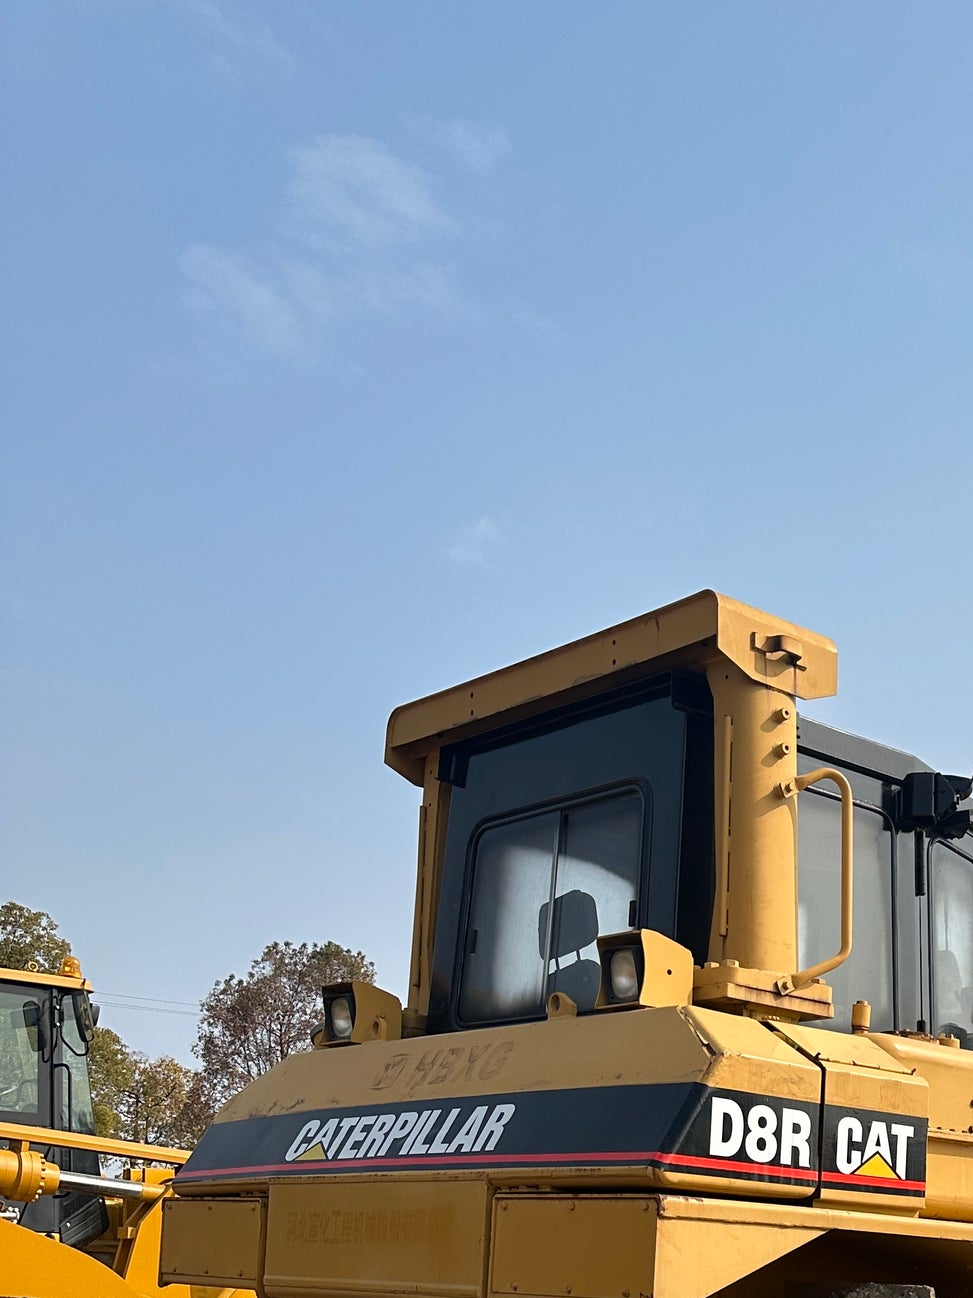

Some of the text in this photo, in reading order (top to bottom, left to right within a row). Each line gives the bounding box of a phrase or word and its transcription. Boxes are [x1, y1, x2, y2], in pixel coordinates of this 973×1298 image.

[285, 1104, 515, 1161] CATERPILLAR
[709, 1097, 811, 1168] D8R
[835, 1116, 914, 1180] CAT
